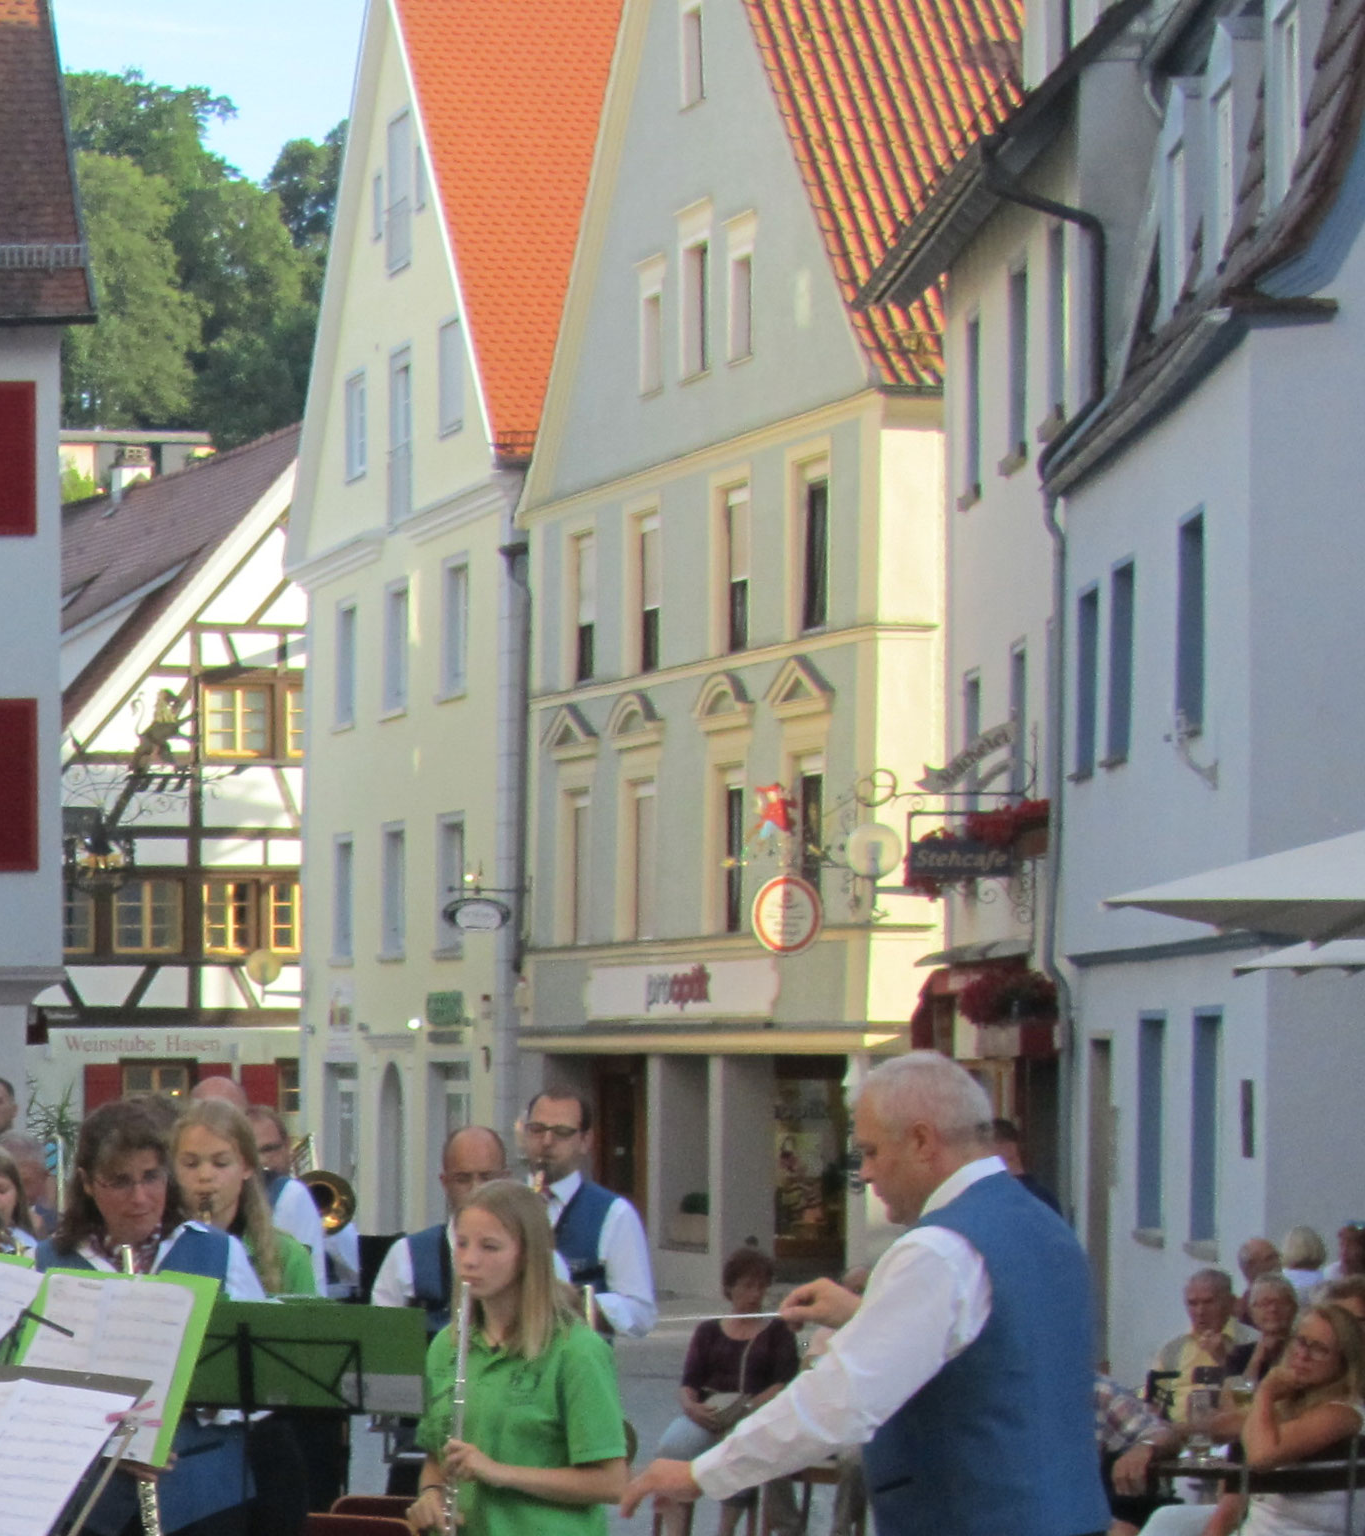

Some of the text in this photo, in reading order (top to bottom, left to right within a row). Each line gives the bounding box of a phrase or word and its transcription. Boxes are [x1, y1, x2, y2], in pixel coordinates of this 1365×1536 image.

[916, 850, 1008, 871] Stehcafe
[65, 1034, 219, 1052] Weinstube Hasen
